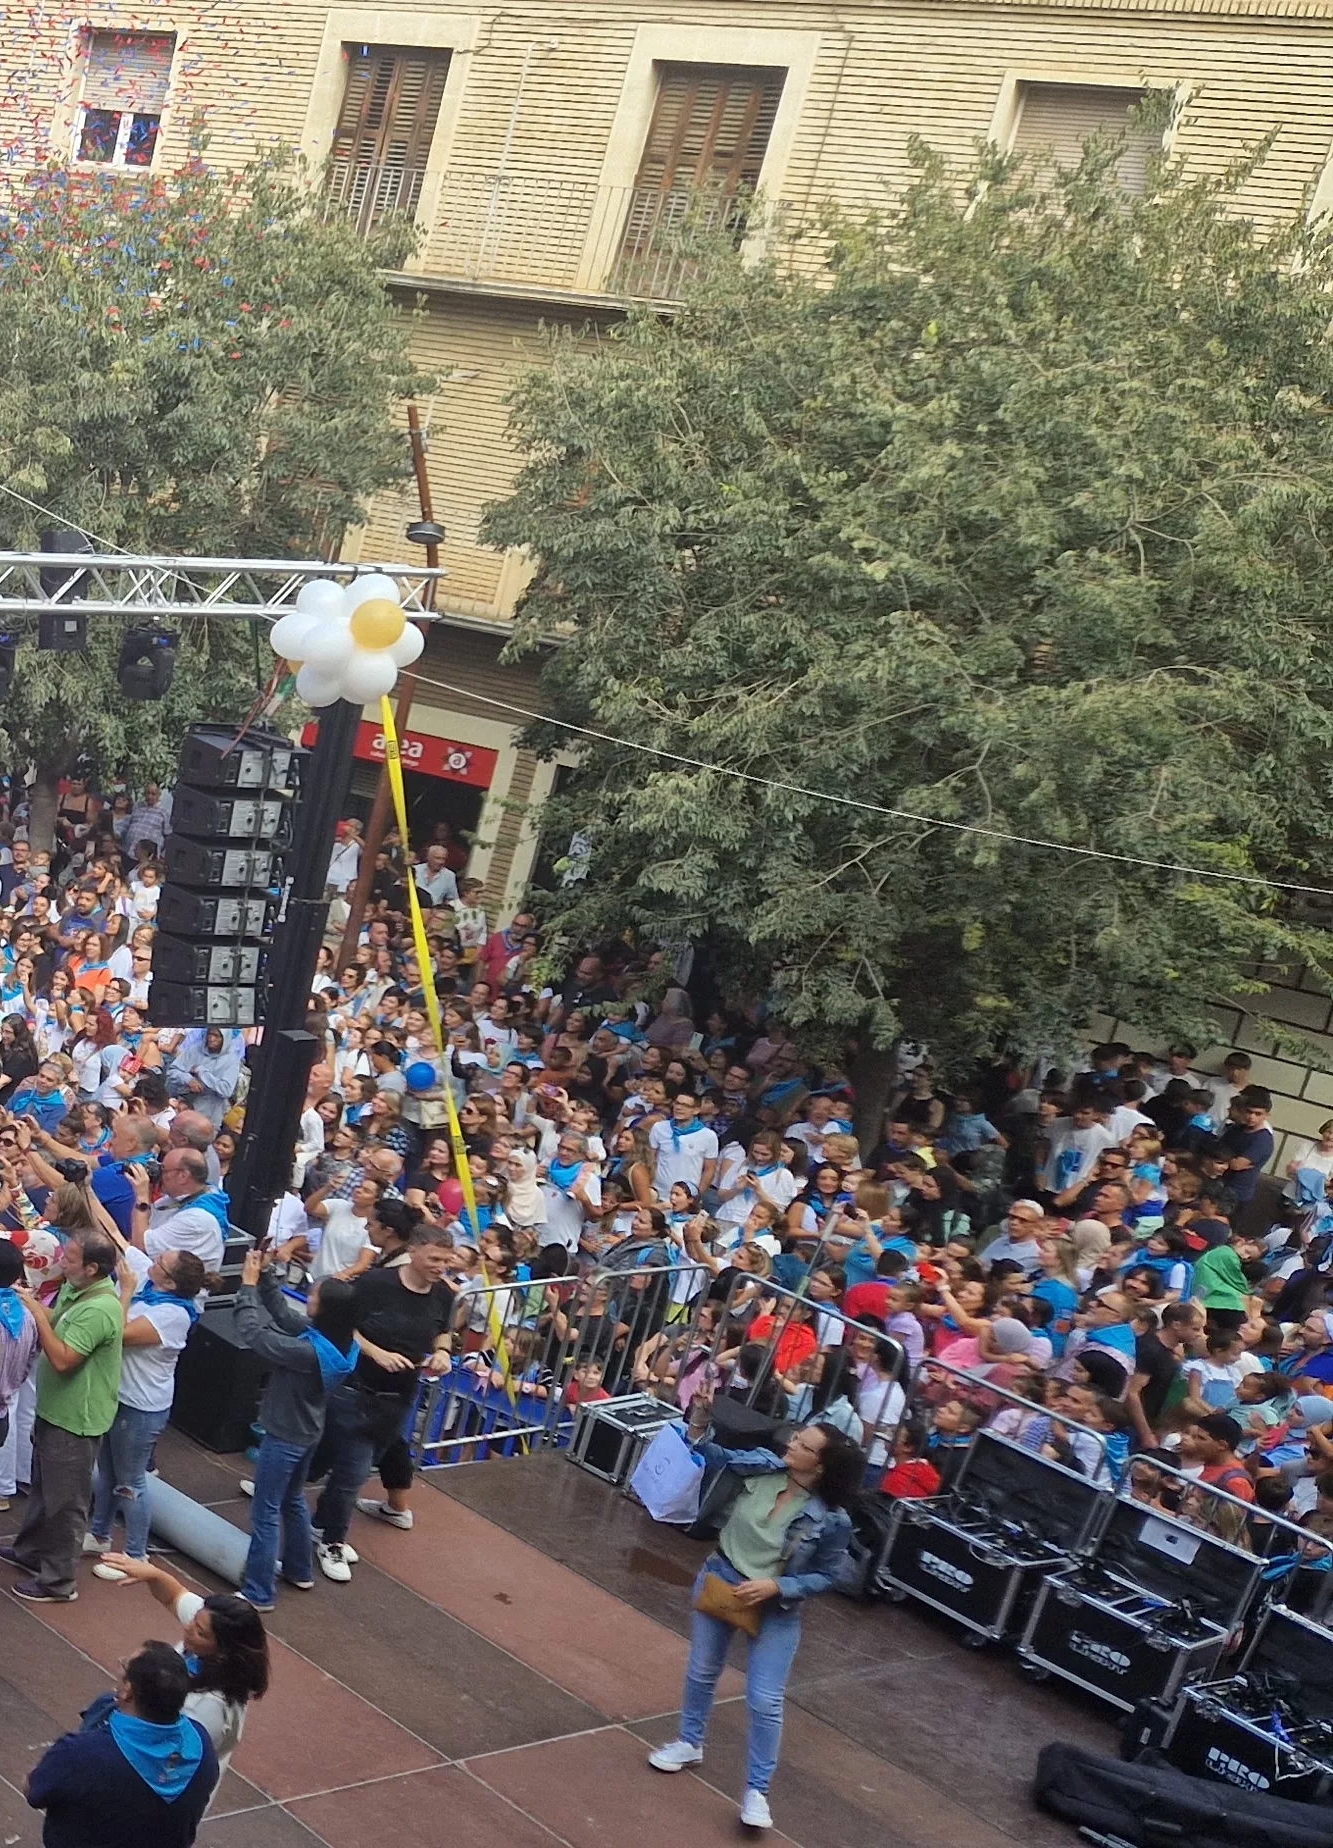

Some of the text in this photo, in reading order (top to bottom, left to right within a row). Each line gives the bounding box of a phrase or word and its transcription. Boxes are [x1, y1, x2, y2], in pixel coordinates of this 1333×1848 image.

[371, 733, 423, 758] aea
[921, 1550, 974, 1585] PRO
[1071, 1630, 1131, 1667] PRO
[1208, 1746, 1270, 1789] PRO
